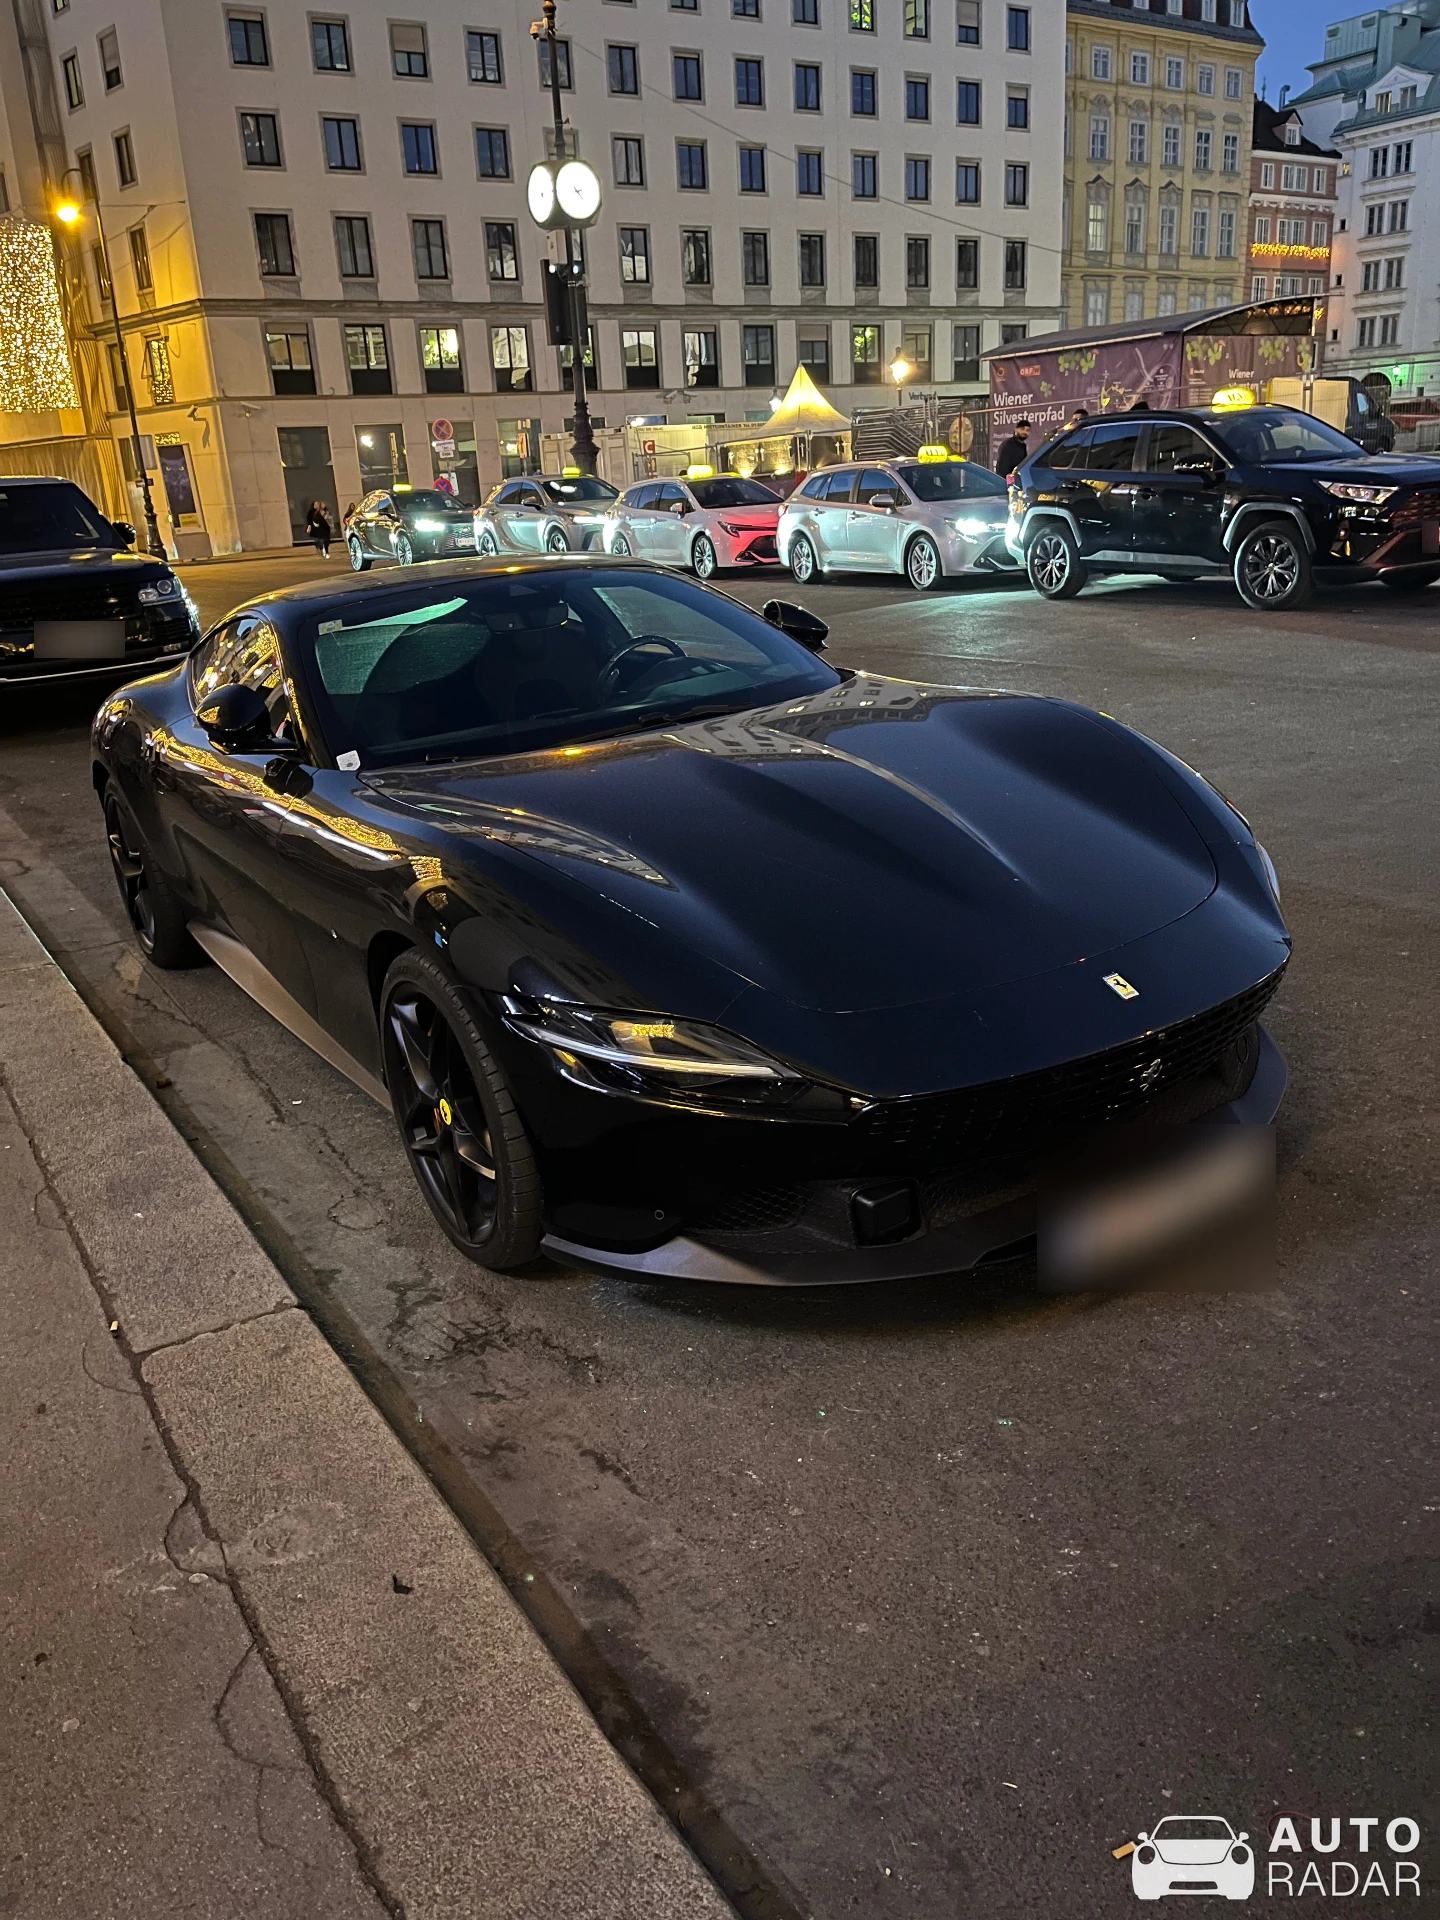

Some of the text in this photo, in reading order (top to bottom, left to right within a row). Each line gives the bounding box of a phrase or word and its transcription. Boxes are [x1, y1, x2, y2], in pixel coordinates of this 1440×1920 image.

[1228, 368, 1255, 379] Wiener
[993, 391, 1034, 407] Wiener
[993, 404, 1066, 426] Silvesterpfad
[644, 441, 654, 453] C
